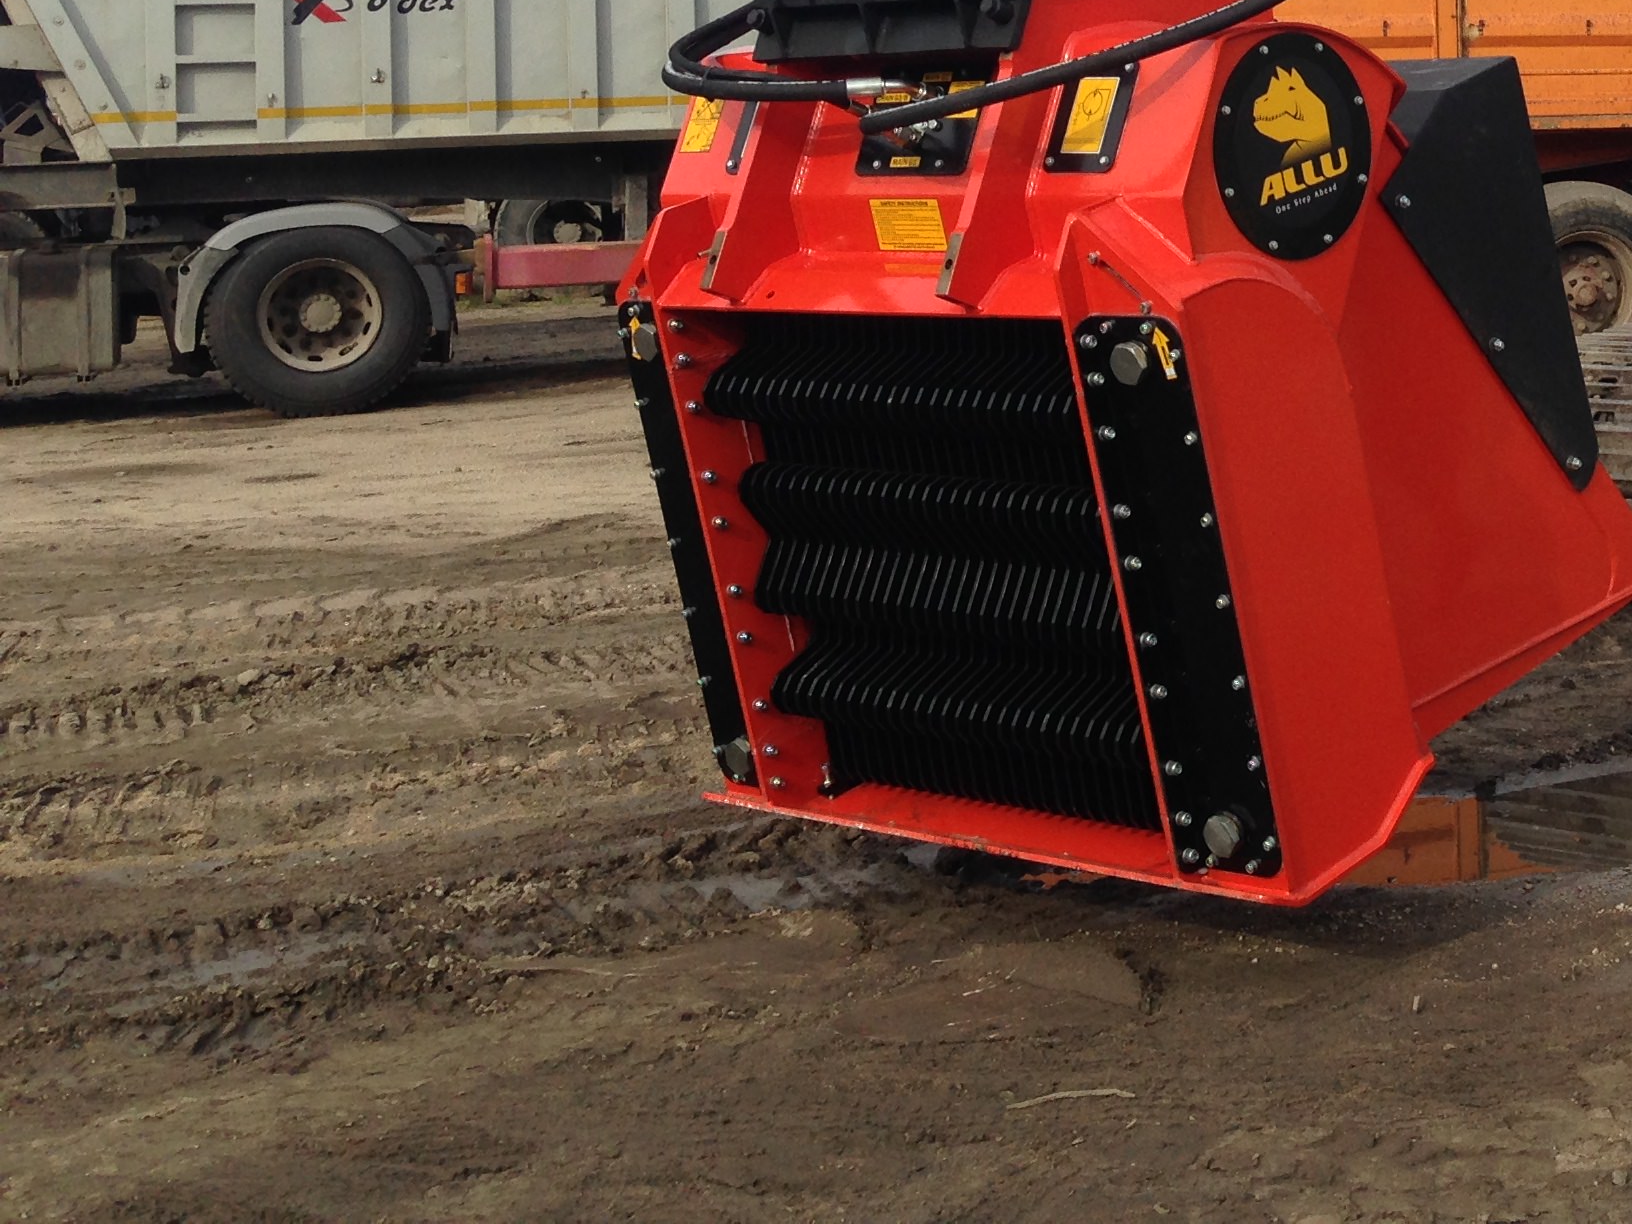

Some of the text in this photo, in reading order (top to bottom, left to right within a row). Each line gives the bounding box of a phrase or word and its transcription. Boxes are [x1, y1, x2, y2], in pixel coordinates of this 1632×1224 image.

[1260, 147, 1348, 206] ALLU
[1275, 183, 1337, 214] One Step Ahead
